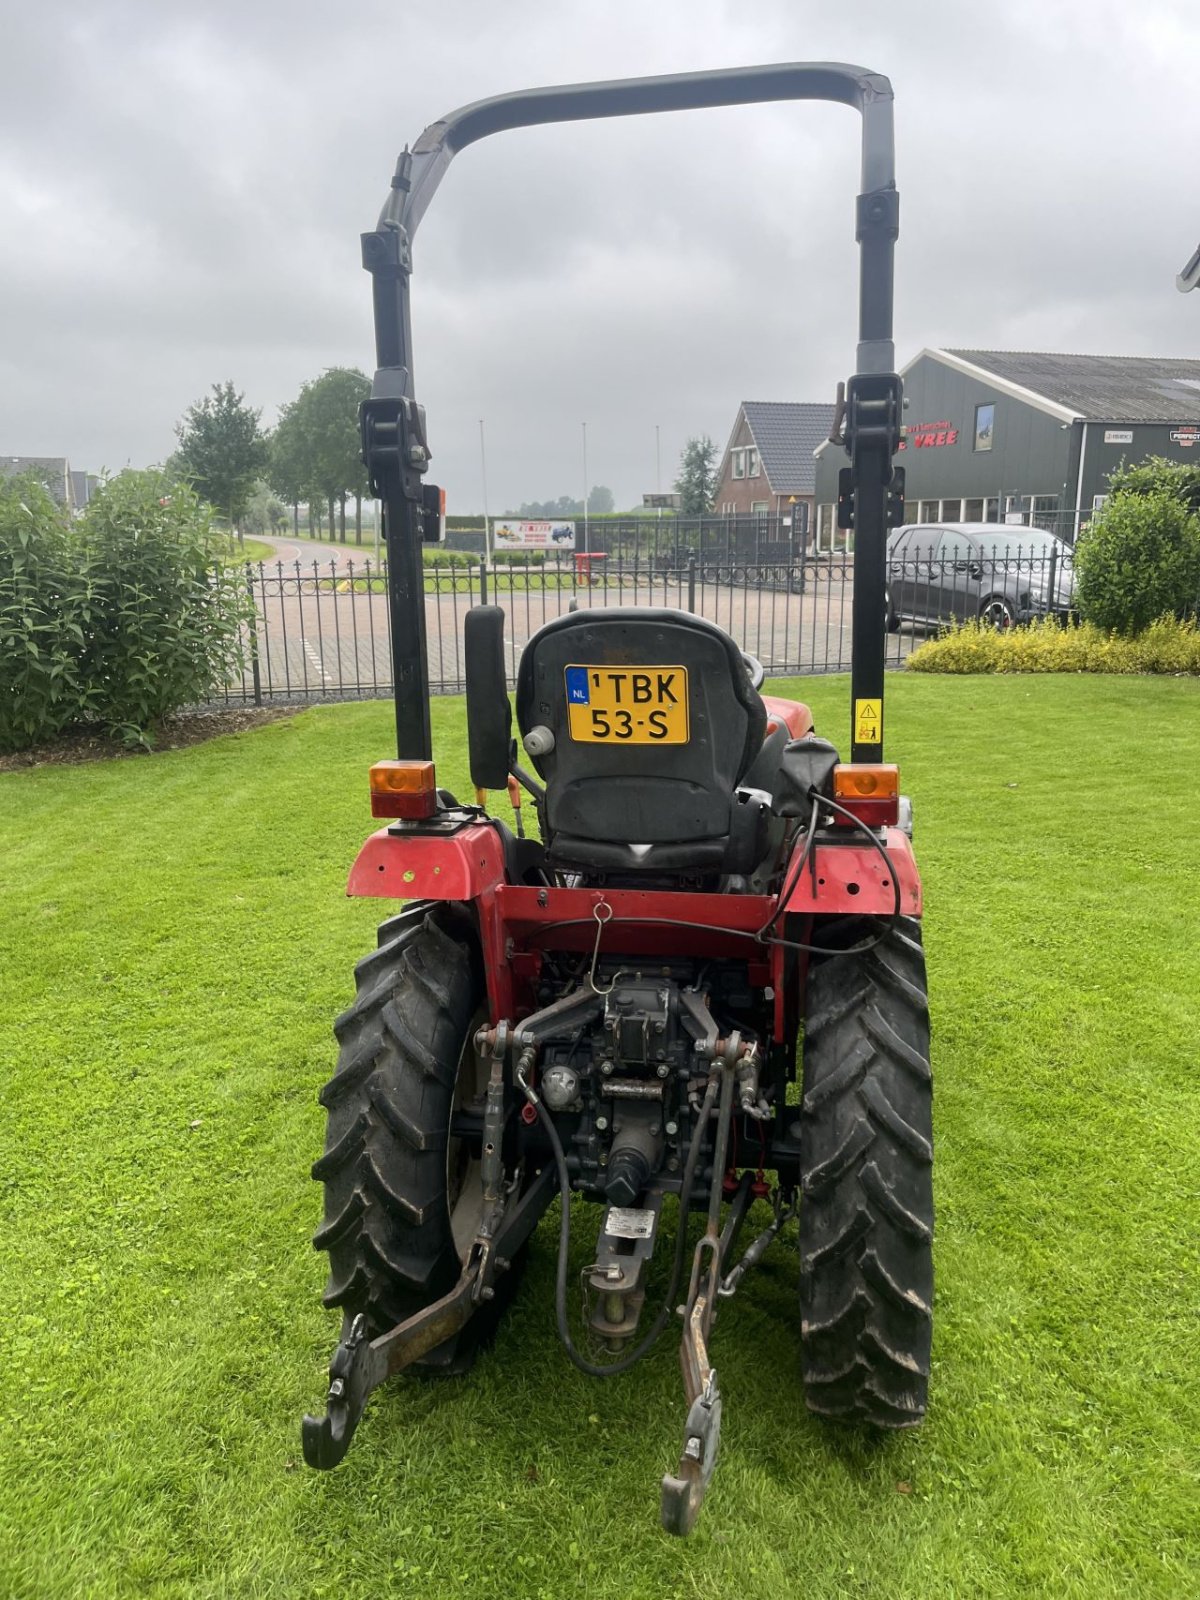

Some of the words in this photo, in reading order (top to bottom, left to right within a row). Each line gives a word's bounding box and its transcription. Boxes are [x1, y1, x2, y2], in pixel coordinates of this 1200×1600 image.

[914, 431, 959, 448] VREE
[573, 690, 586, 699] NL
[591, 709, 668, 739] 53-S
